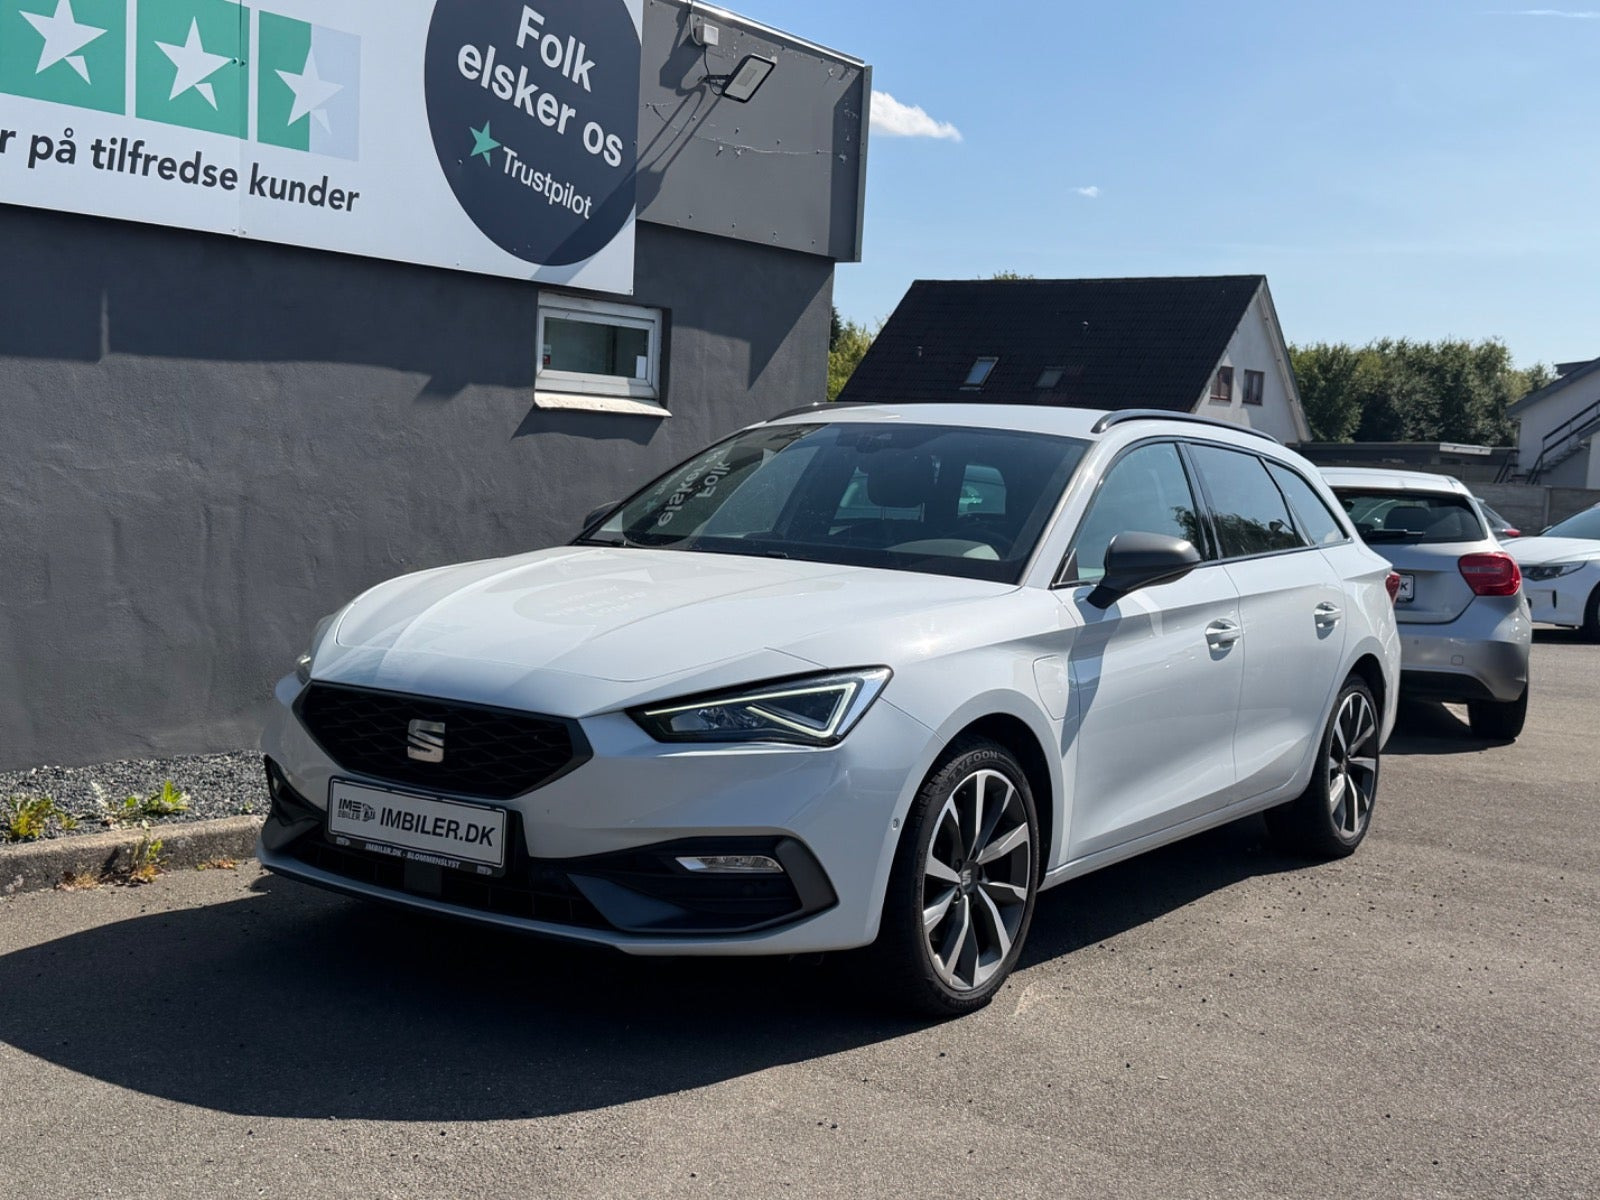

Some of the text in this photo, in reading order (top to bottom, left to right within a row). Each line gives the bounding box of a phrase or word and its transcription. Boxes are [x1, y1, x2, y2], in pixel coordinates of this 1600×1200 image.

[515, 4, 597, 93] Folk
[457, 44, 623, 168] elsker os
[27, 127, 77, 169] på
[90, 136, 238, 191] tilfredse
[248, 162, 360, 212] kunder
[502, 146, 593, 220] Trustpilot
[380, 806, 496, 848] IMBILER.DK
